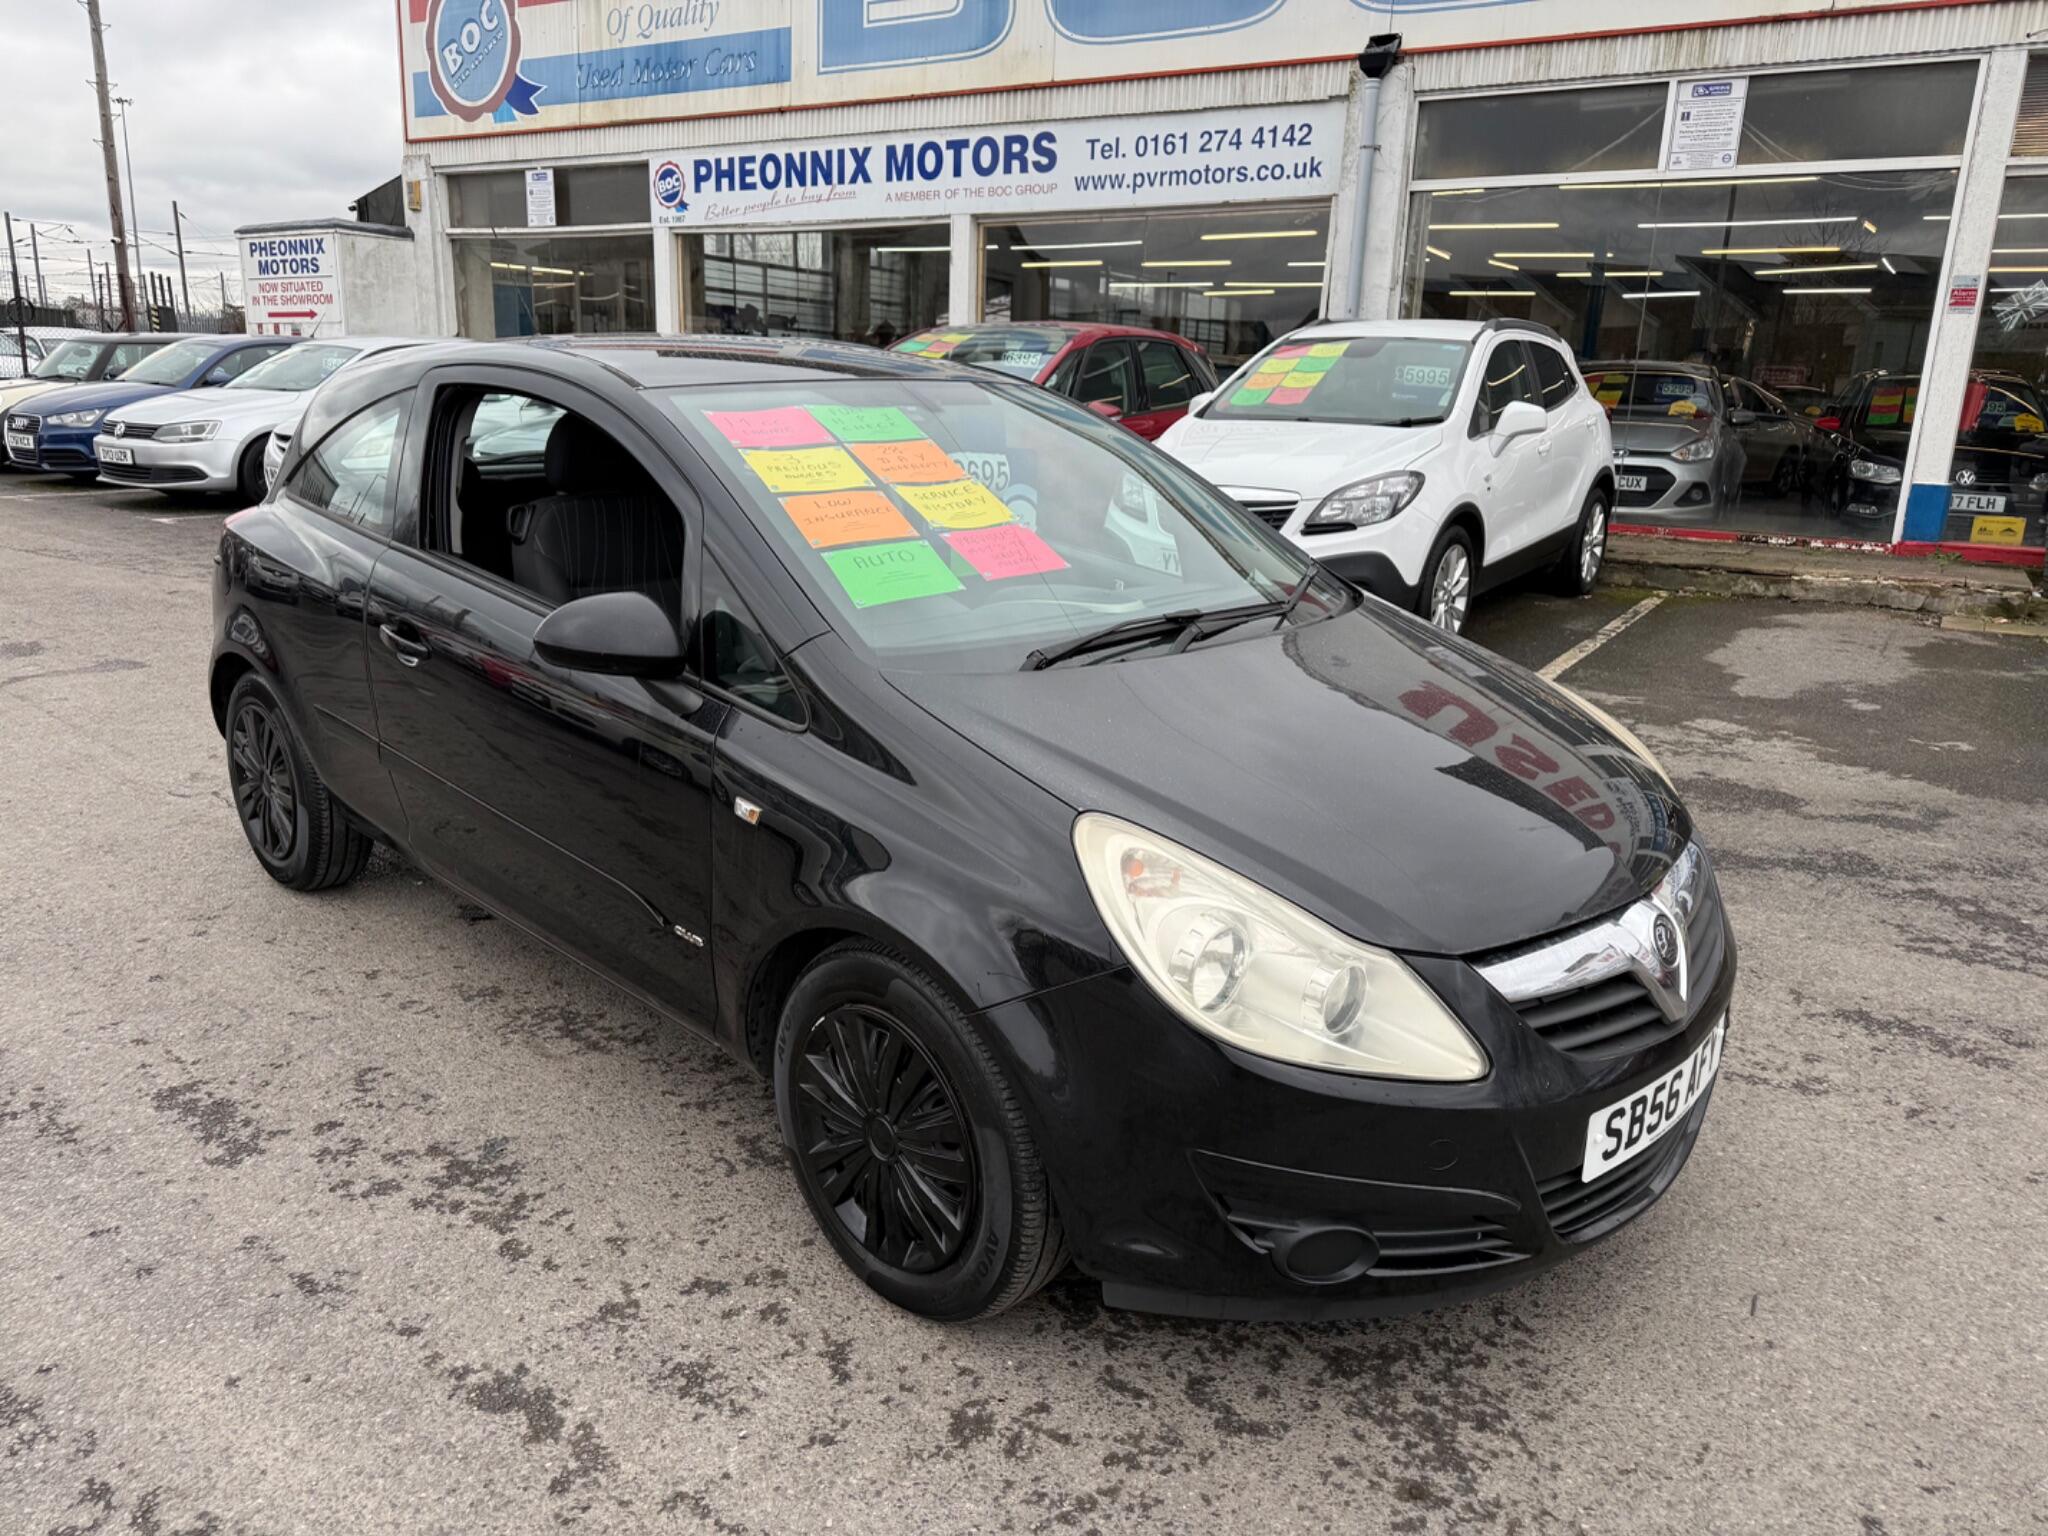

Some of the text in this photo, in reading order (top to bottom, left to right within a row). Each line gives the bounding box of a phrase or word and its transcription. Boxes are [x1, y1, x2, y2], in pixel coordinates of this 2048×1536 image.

[607, 0, 720, 43] Of Quality
[442, 0, 500, 78] BOC
[576, 48, 757, 90] Used Motor Cars
[1086, 122, 1313, 160] Tel. 0161 274 4142
[693, 131, 1058, 194] PHEONNIX MOTORS
[658, 174, 681, 193] BOC
[1074, 156, 1323, 194] www.pvrmotors.co.uk
[743, 191, 781, 215] people
[786, 192, 797, 205] to
[826, 184, 857, 202] from
[885, 183, 1058, 202] A MEMBER OF THE BOC GROUP
[249, 238, 326, 258] PHEONNIX
[258, 257, 320, 276] MOTORS
[259, 281, 324, 294] NOW SITUATED
[252, 293, 334, 306] IN THE SHOWROOM
[913, 484, 976, 501] SERVICE
[814, 498, 852, 509] LOW
[923, 495, 986, 512] HISTORY
[1966, 496, 1996, 510] FLH
[803, 505, 894, 526] INSURANCE
[854, 550, 915, 570] AUTO
[1601, 1069, 1684, 1161] SB56
